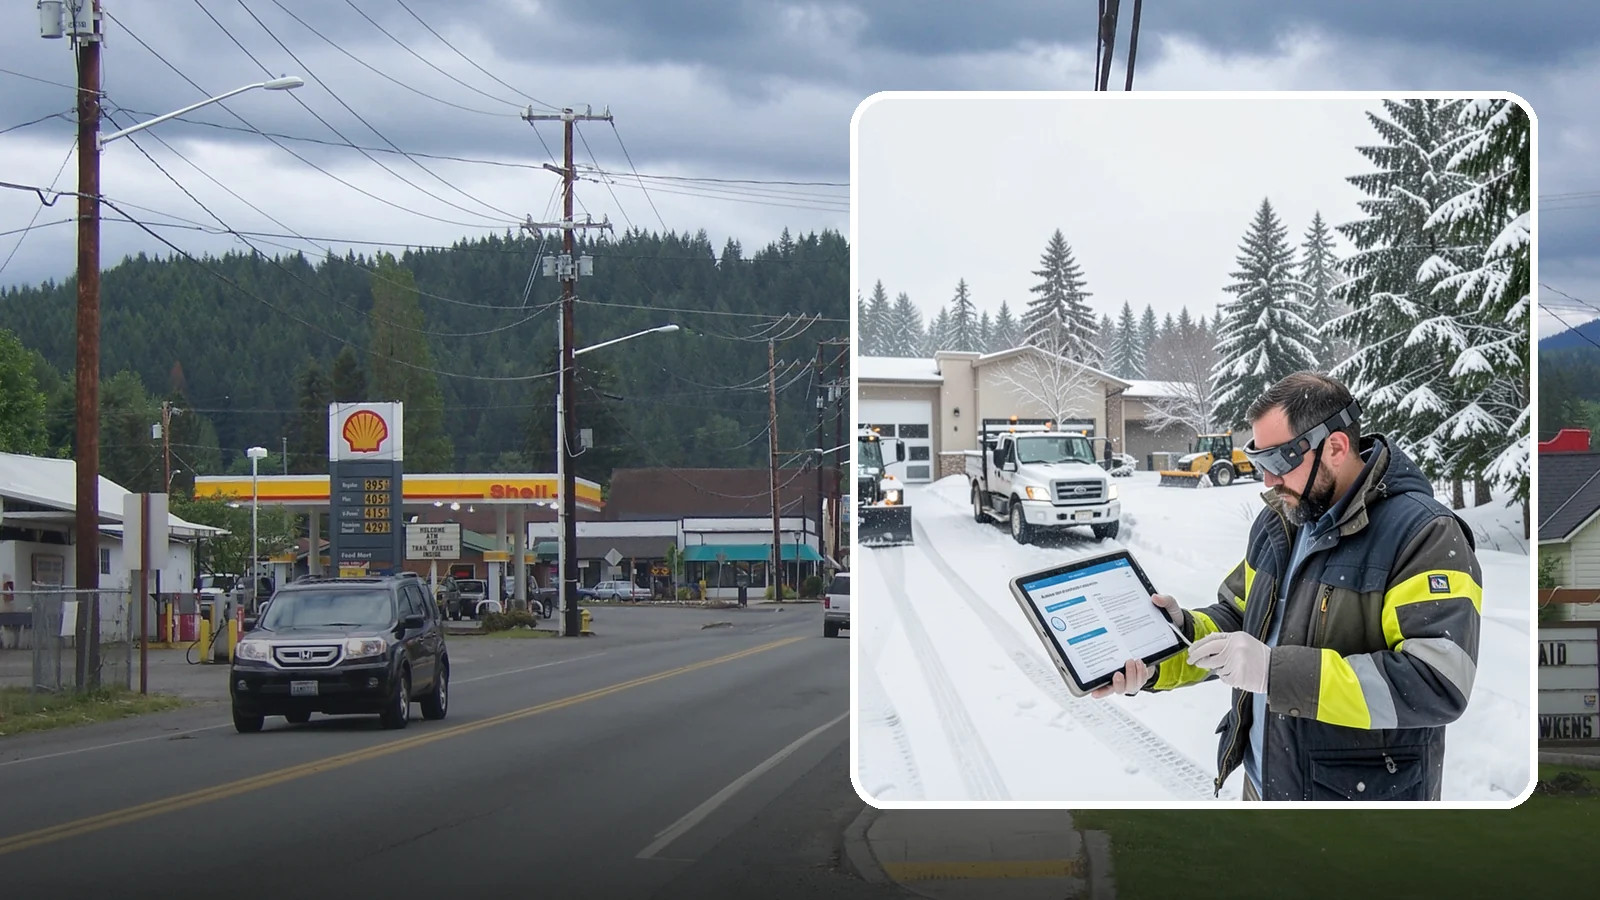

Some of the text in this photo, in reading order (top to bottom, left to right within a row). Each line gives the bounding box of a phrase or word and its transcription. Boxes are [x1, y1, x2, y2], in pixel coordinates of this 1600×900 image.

[366, 480, 383, 490] 395
[490, 484, 547, 499] Shell
[366, 494, 383, 504] 405
[366, 508, 383, 518] 415
[366, 522, 383, 532] 429
[1538, 642, 1567, 666] AID
